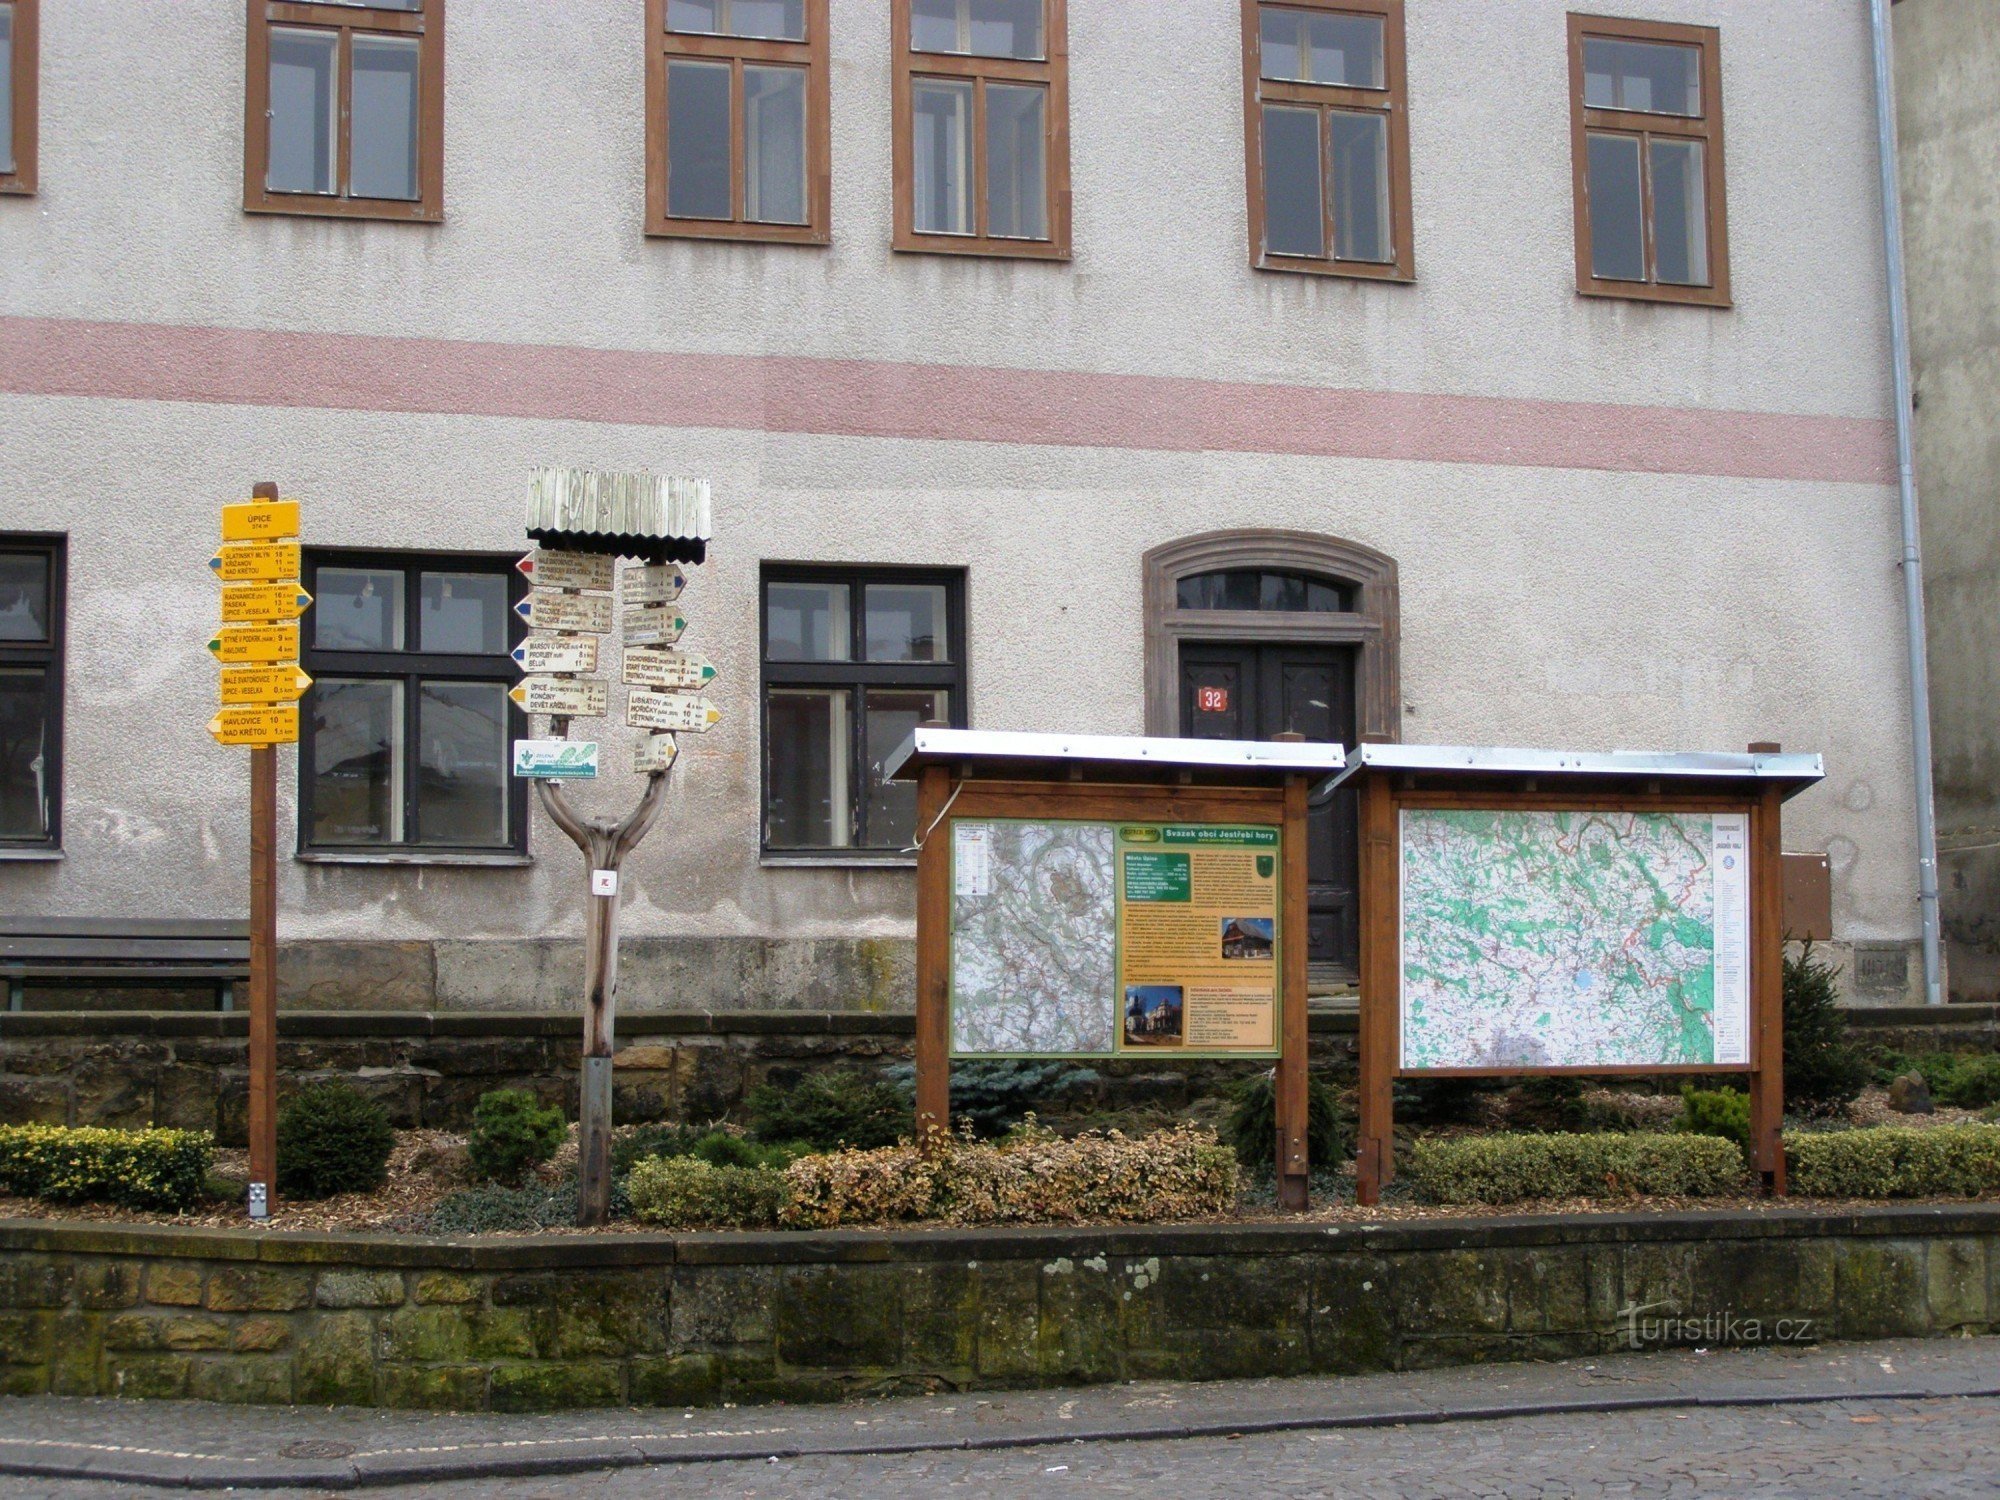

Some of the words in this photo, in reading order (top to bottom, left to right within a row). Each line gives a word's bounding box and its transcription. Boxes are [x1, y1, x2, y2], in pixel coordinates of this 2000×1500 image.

[248, 514, 272, 523] ÚPICE
[631, 696, 662, 705] LIBŇATOV
[1206, 691, 1221, 707] 32
[223, 717, 261, 725] HAVLOVICE
[1219, 830, 1254, 838] Jestřebí
[1256, 831, 1274, 840] hory
